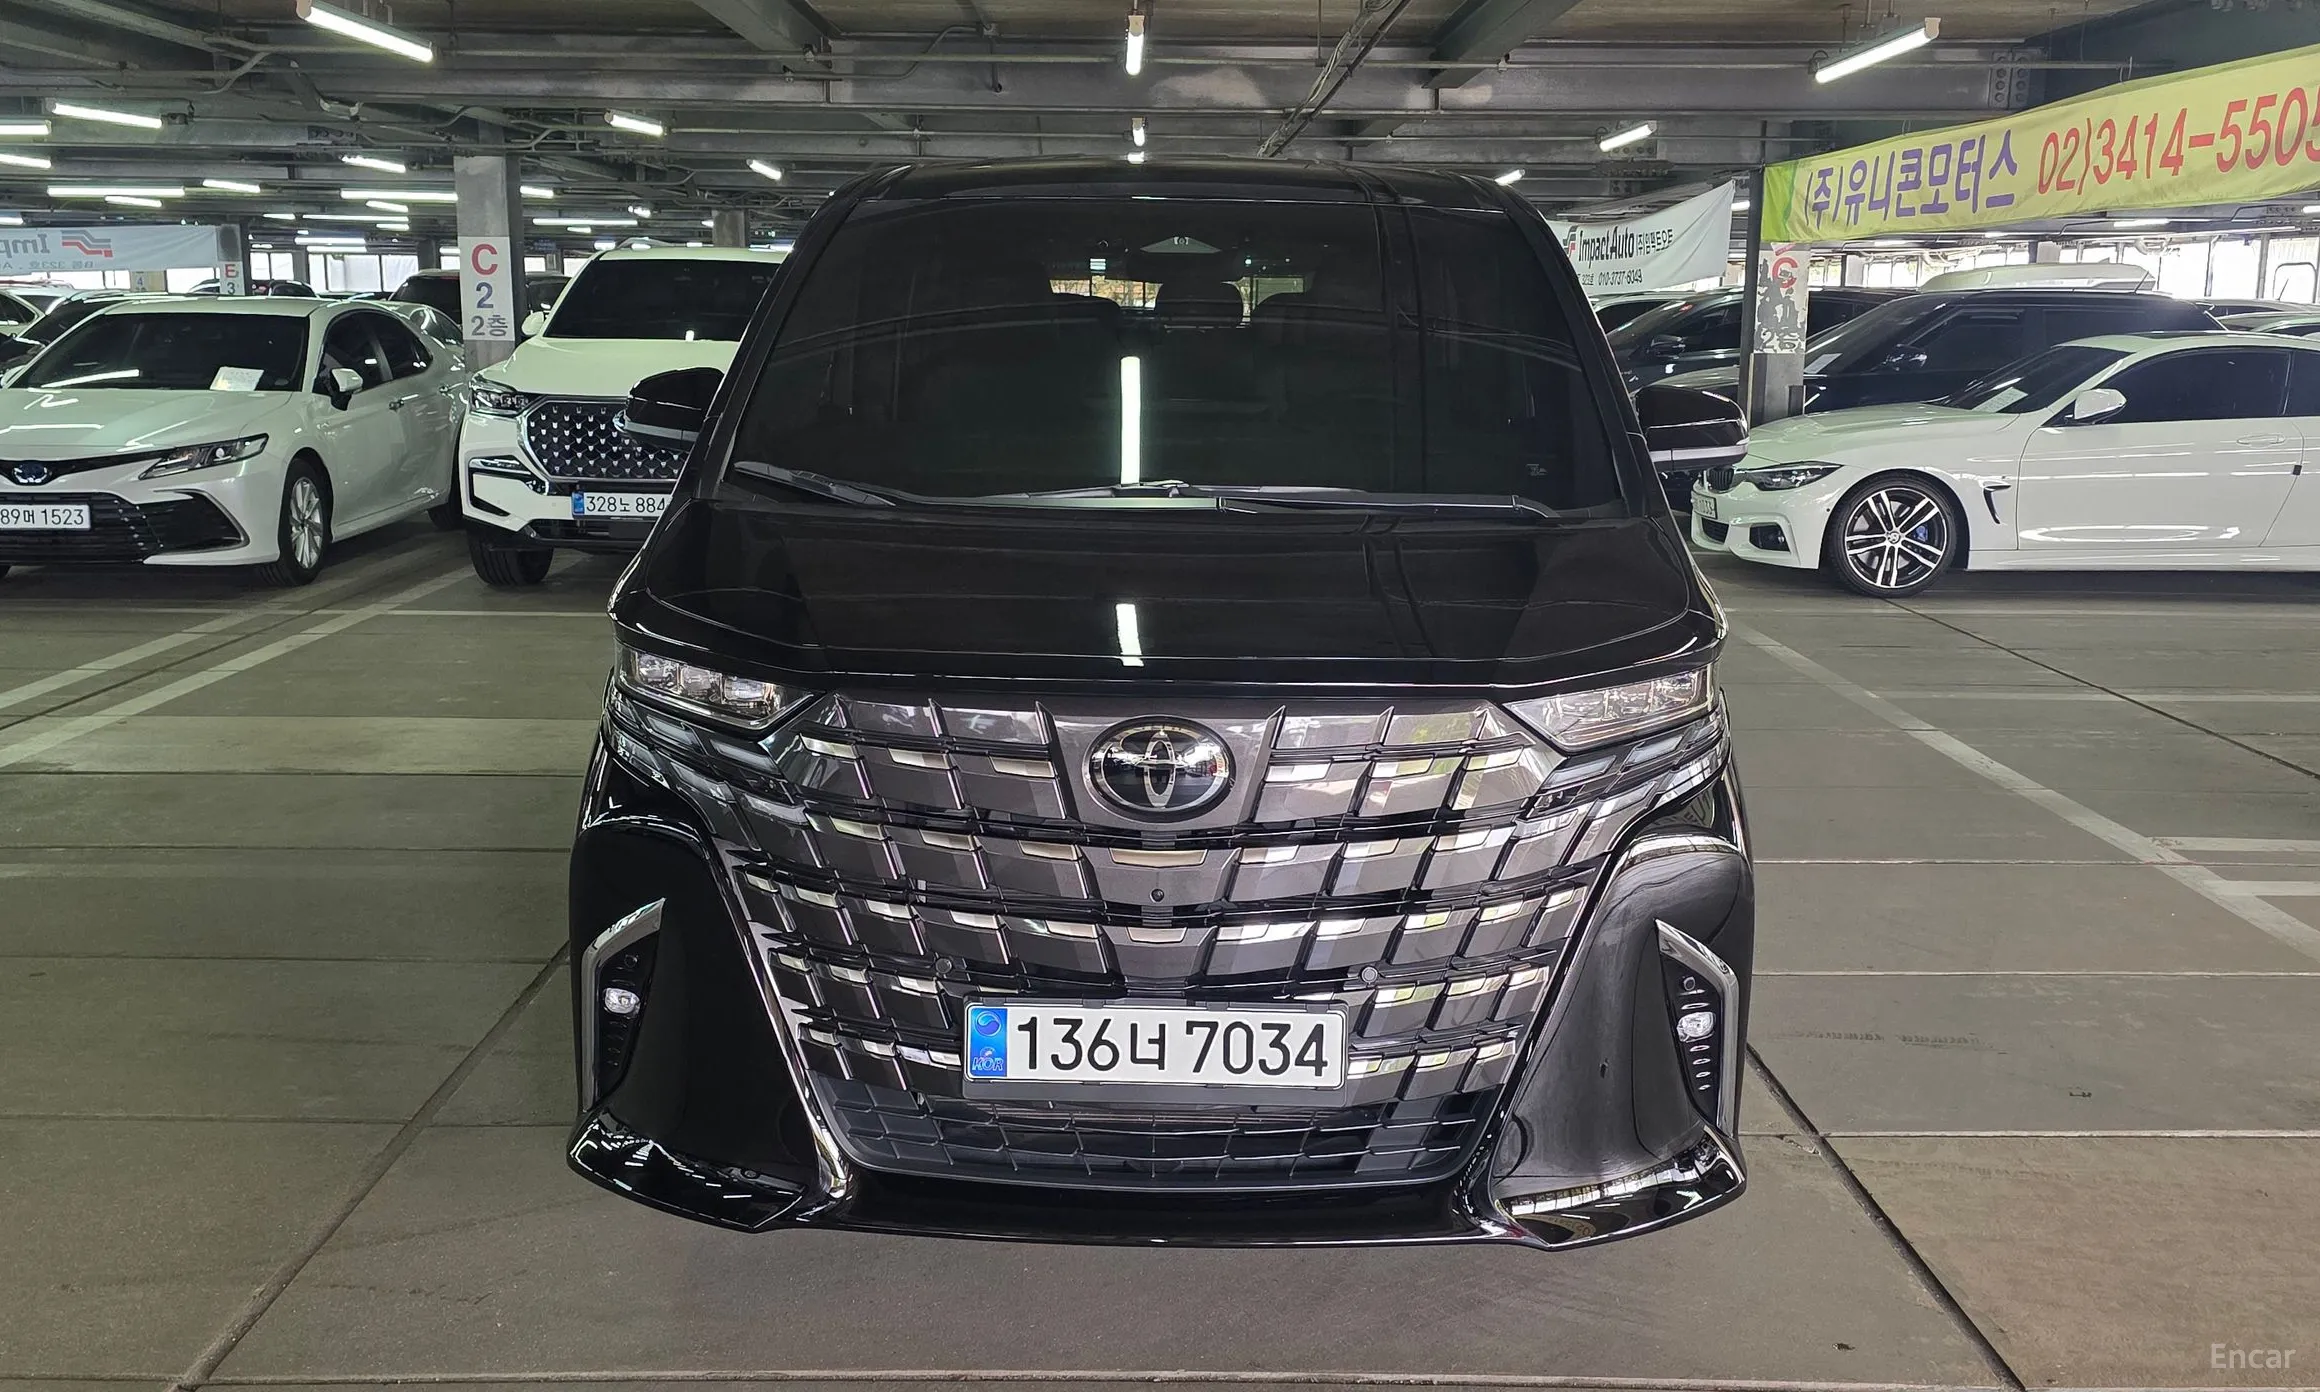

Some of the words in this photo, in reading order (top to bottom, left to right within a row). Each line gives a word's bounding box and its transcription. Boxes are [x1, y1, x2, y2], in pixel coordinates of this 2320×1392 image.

[1804, 129, 2018, 230] (주)유니콘모터스
[471, 243, 499, 276] C
[225, 263, 238, 278] E
[226, 282, 236, 295] 3
[476, 281, 494, 308] 2
[471, 314, 508, 337] 2층
[586, 496, 631, 512] 328노
[0, 508, 35, 525] 89머
[41, 508, 84, 525] 1523
[1017, 1016, 1166, 1072] 136너
[1186, 1020, 1328, 1077] 7034
[972, 1056, 1004, 1072] KOR
